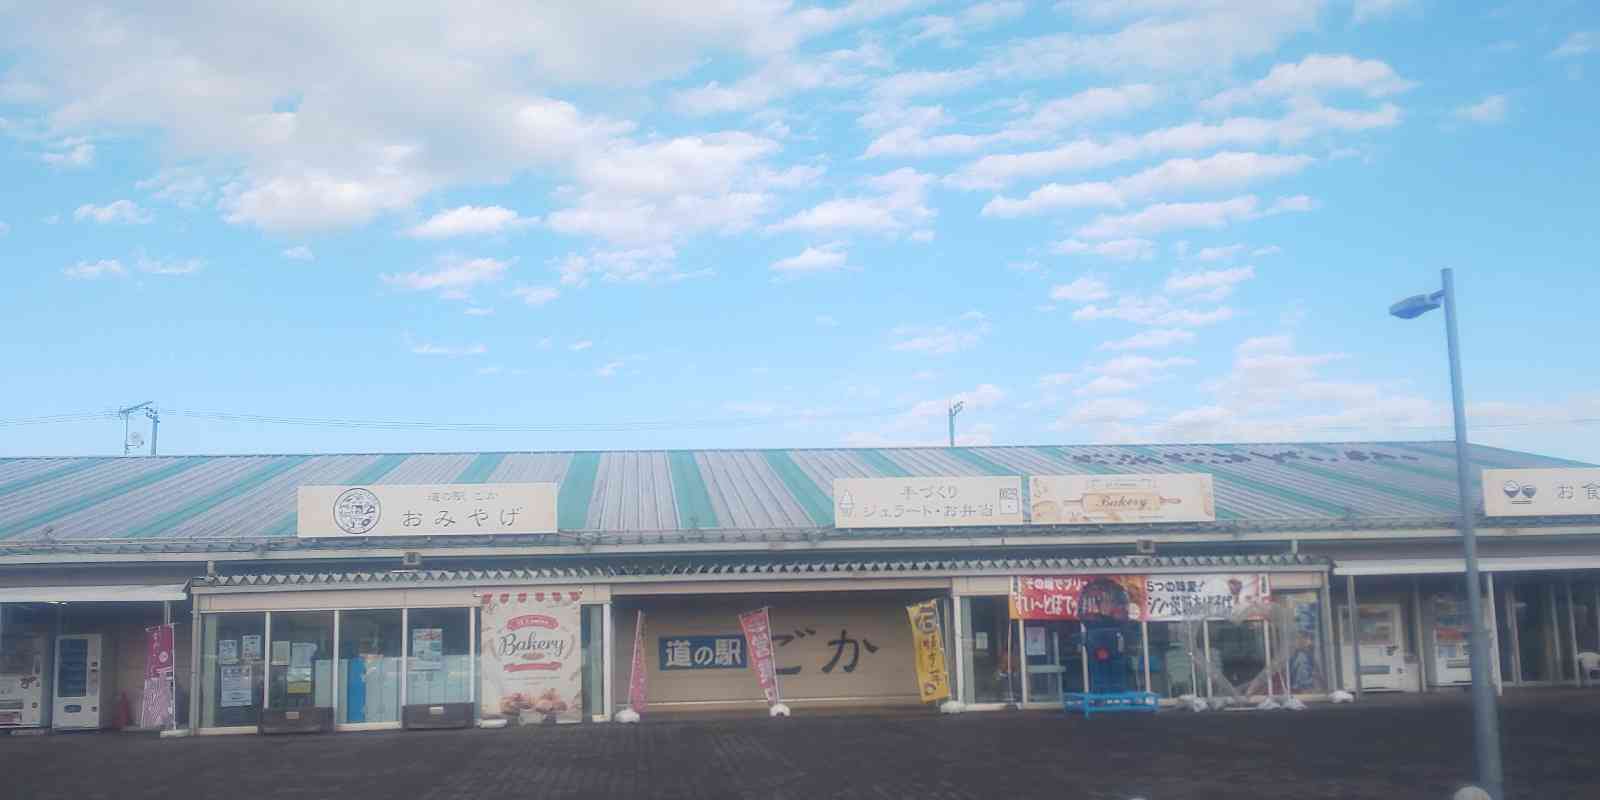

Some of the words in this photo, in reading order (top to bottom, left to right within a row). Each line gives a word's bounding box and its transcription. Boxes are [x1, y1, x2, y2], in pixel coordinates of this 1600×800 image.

[899, 485, 956, 500] 手づくり
[1096, 495, 1147, 509] Bakery
[402, 505, 523, 527] おみやげ
[499, 632, 564, 656] Bakery
[665, 638, 742, 667] 道の駅
